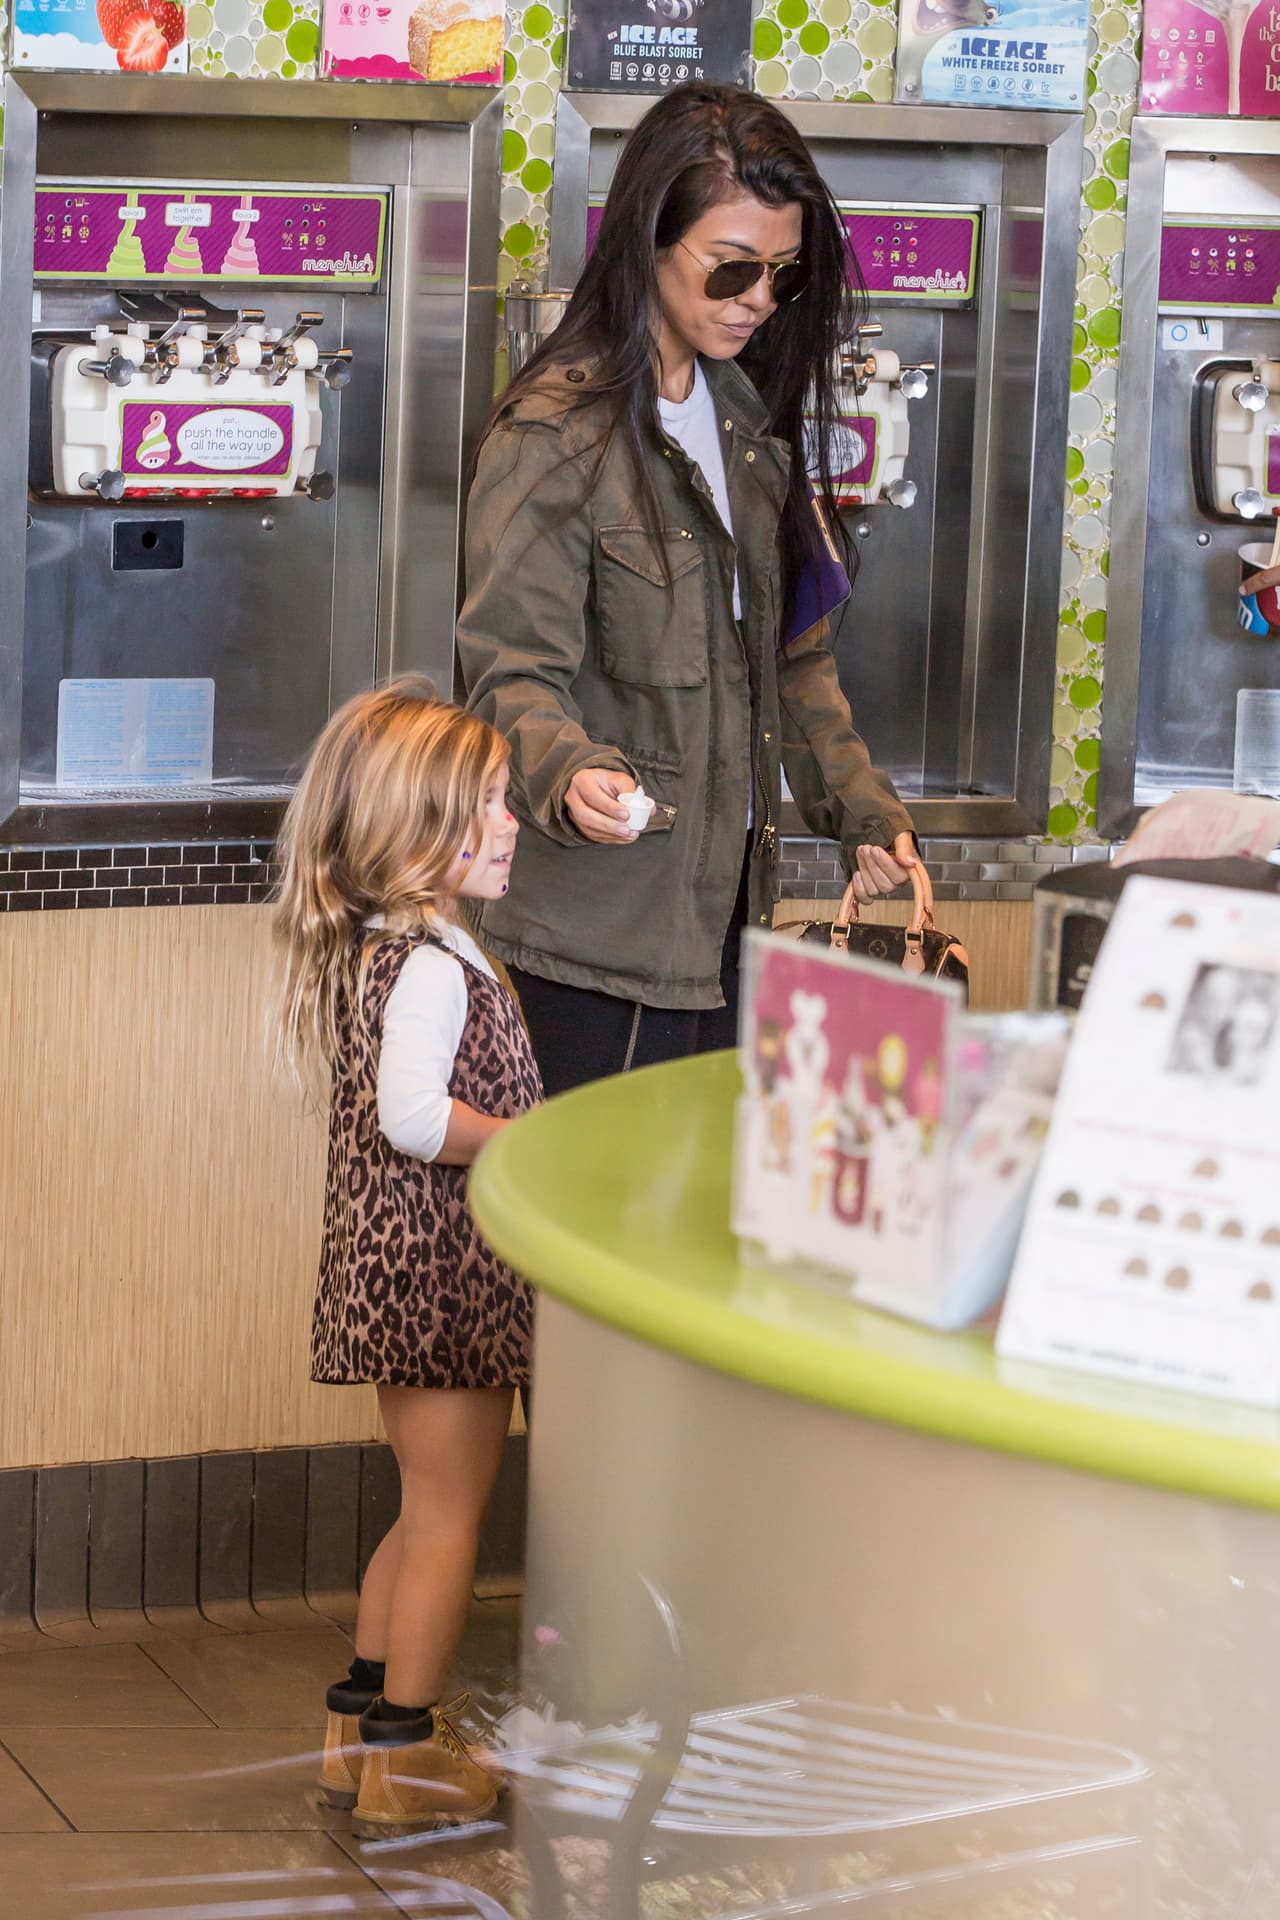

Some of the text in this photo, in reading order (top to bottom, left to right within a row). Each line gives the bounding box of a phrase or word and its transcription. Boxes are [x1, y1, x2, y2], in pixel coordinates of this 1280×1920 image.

[620, 25, 698, 45] ICE AGE
[1259, 26, 1275, 42] the
[613, 44, 703, 59] BLUE BLAST SORBET
[960, 37, 1048, 60] ICE AGE
[942, 57, 1065, 75] WHITE FREEZE SORBET
[173, 215, 203, 223] together
[184, 427, 278, 440] push the handle
[191, 440, 272, 452] all the way up
